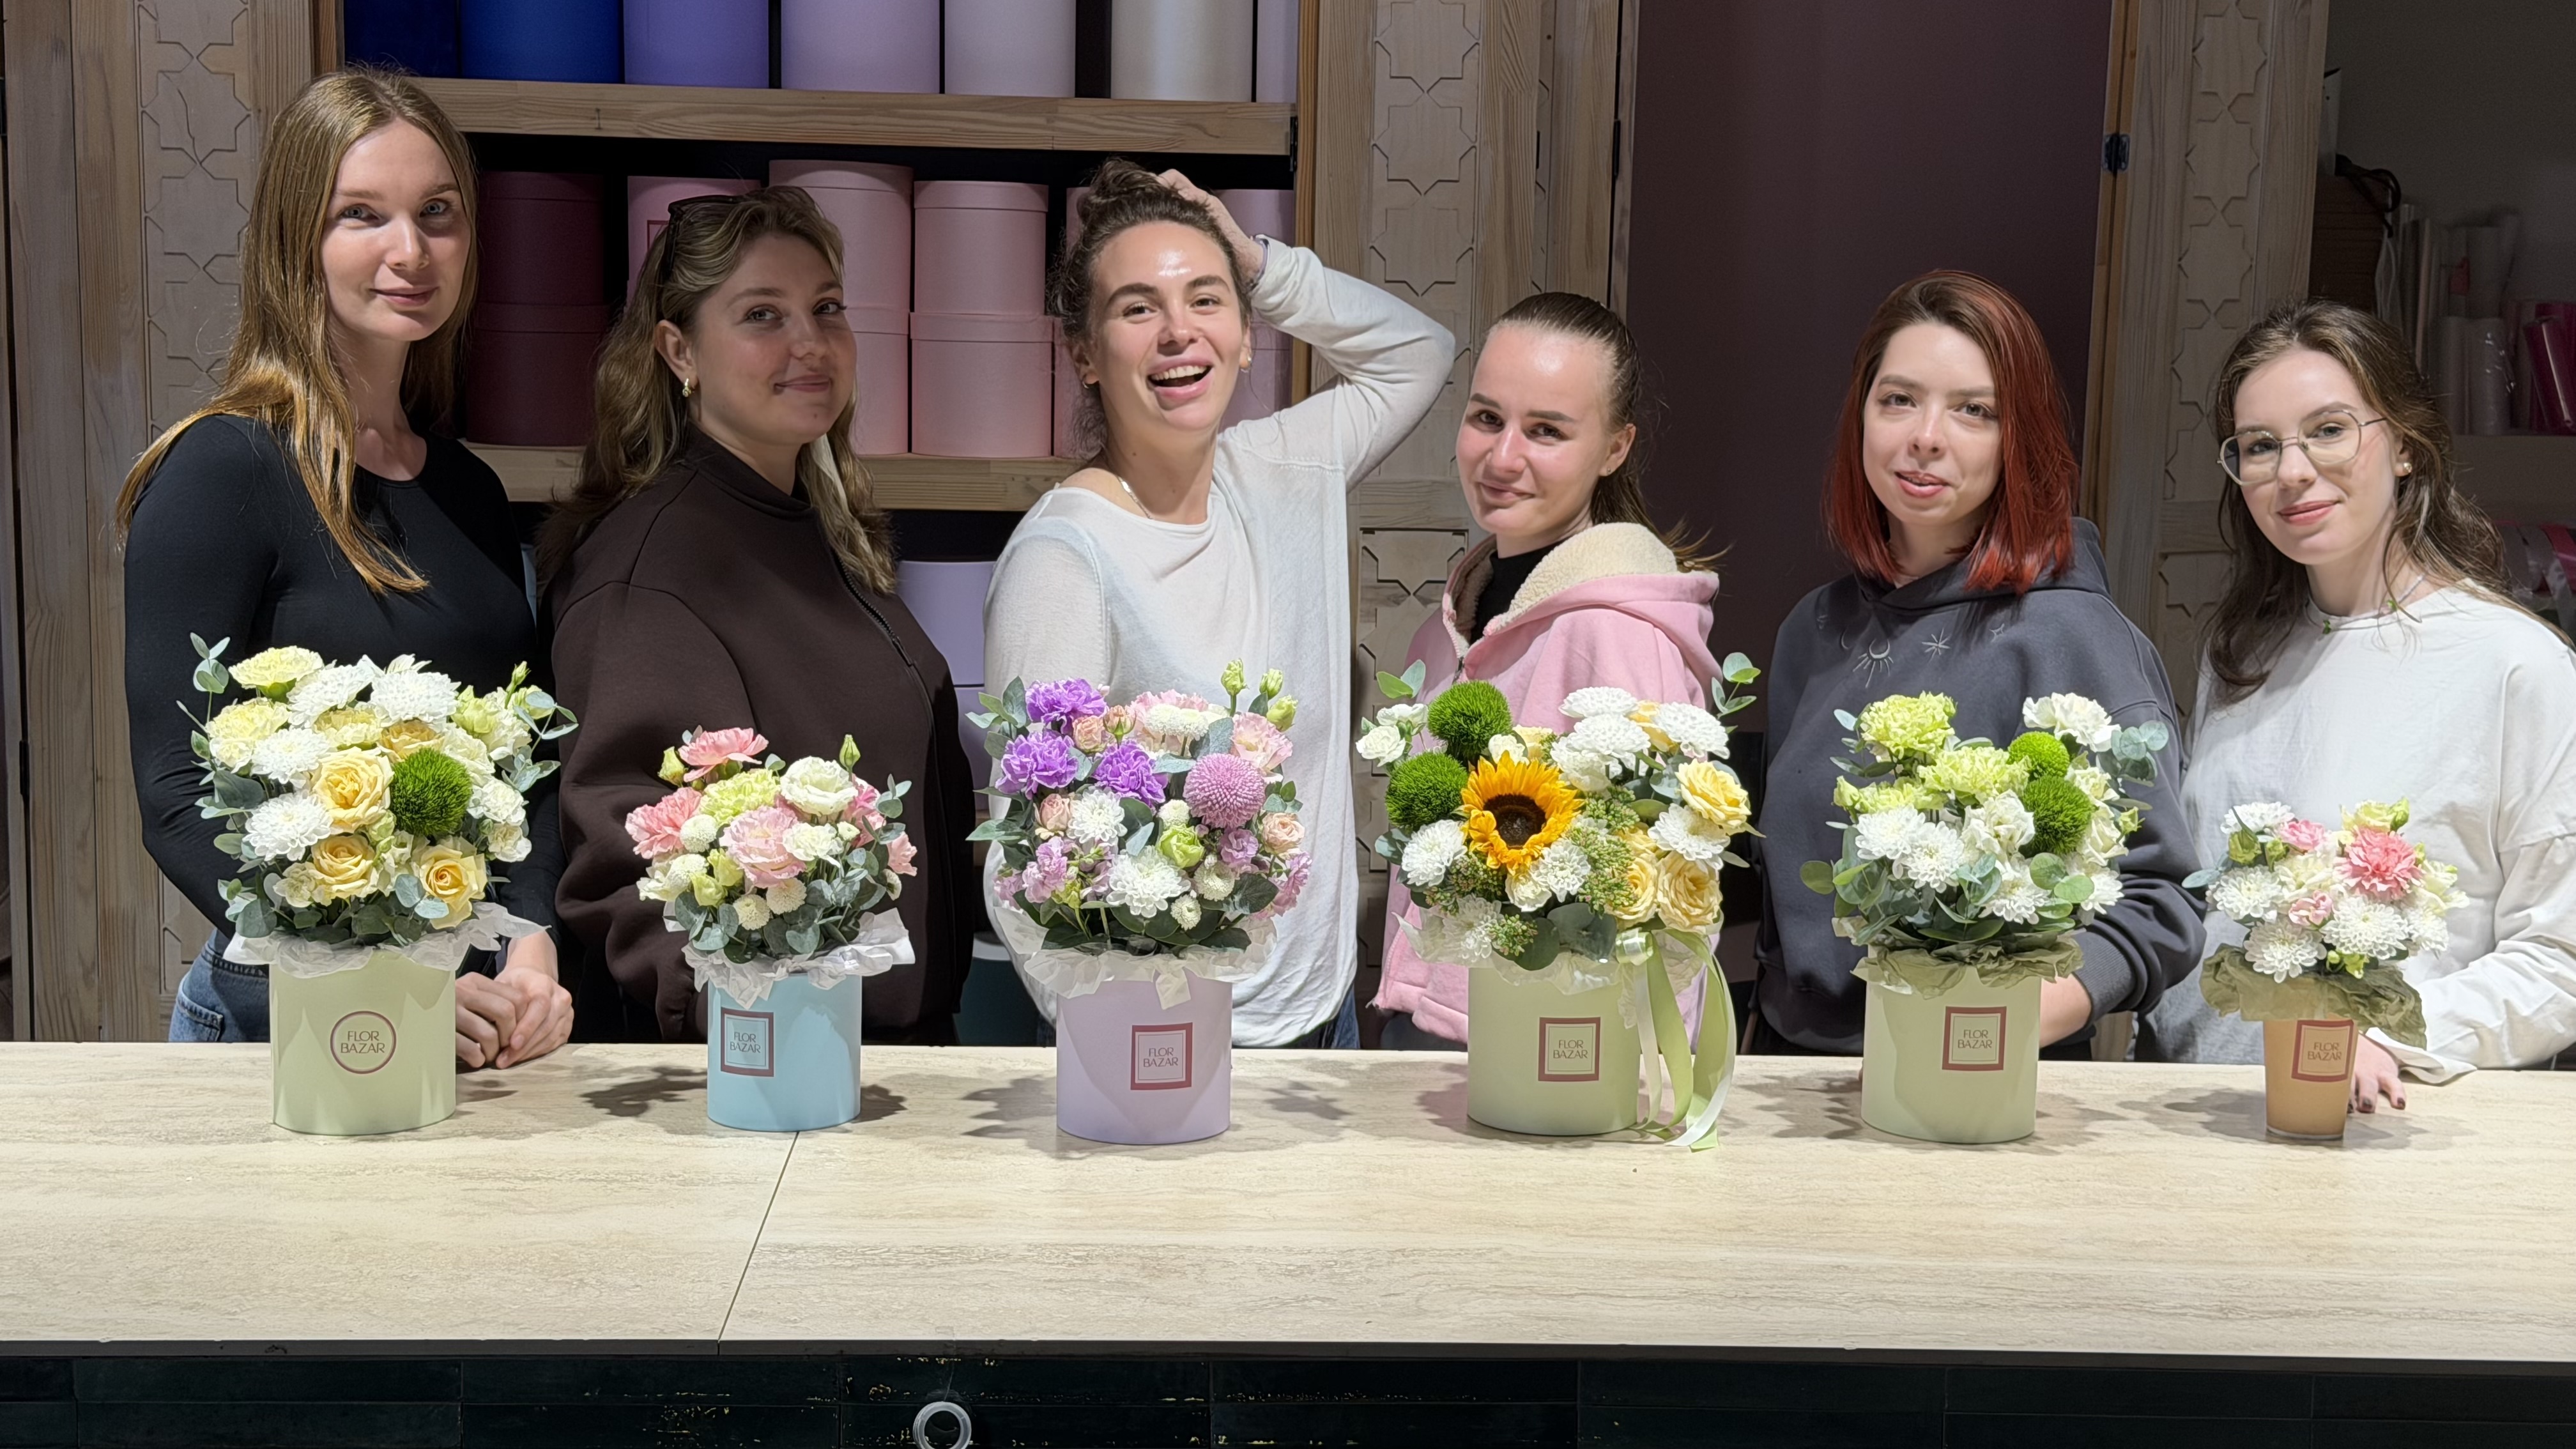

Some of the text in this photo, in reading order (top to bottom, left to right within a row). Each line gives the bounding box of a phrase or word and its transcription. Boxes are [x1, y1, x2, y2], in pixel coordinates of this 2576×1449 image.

[347, 1031, 379, 1041] FLOR
[733, 1031, 756, 1043] FLOR
[1963, 1029, 1988, 1038] FLOR
[341, 1043, 385, 1054] BAZAR
[730, 1041, 761, 1053] BAZAR
[1558, 1039, 1584, 1048] FLOR
[1958, 1039, 1993, 1048] BAZAR
[2313, 1042, 2339, 1051] FLOR
[1148, 1047, 1174, 1057] FLOR
[1552, 1049, 1588, 1059] BAZAR
[2307, 1051, 2342, 1061] BAZAR
[1143, 1057, 1179, 1068] BAZAR
